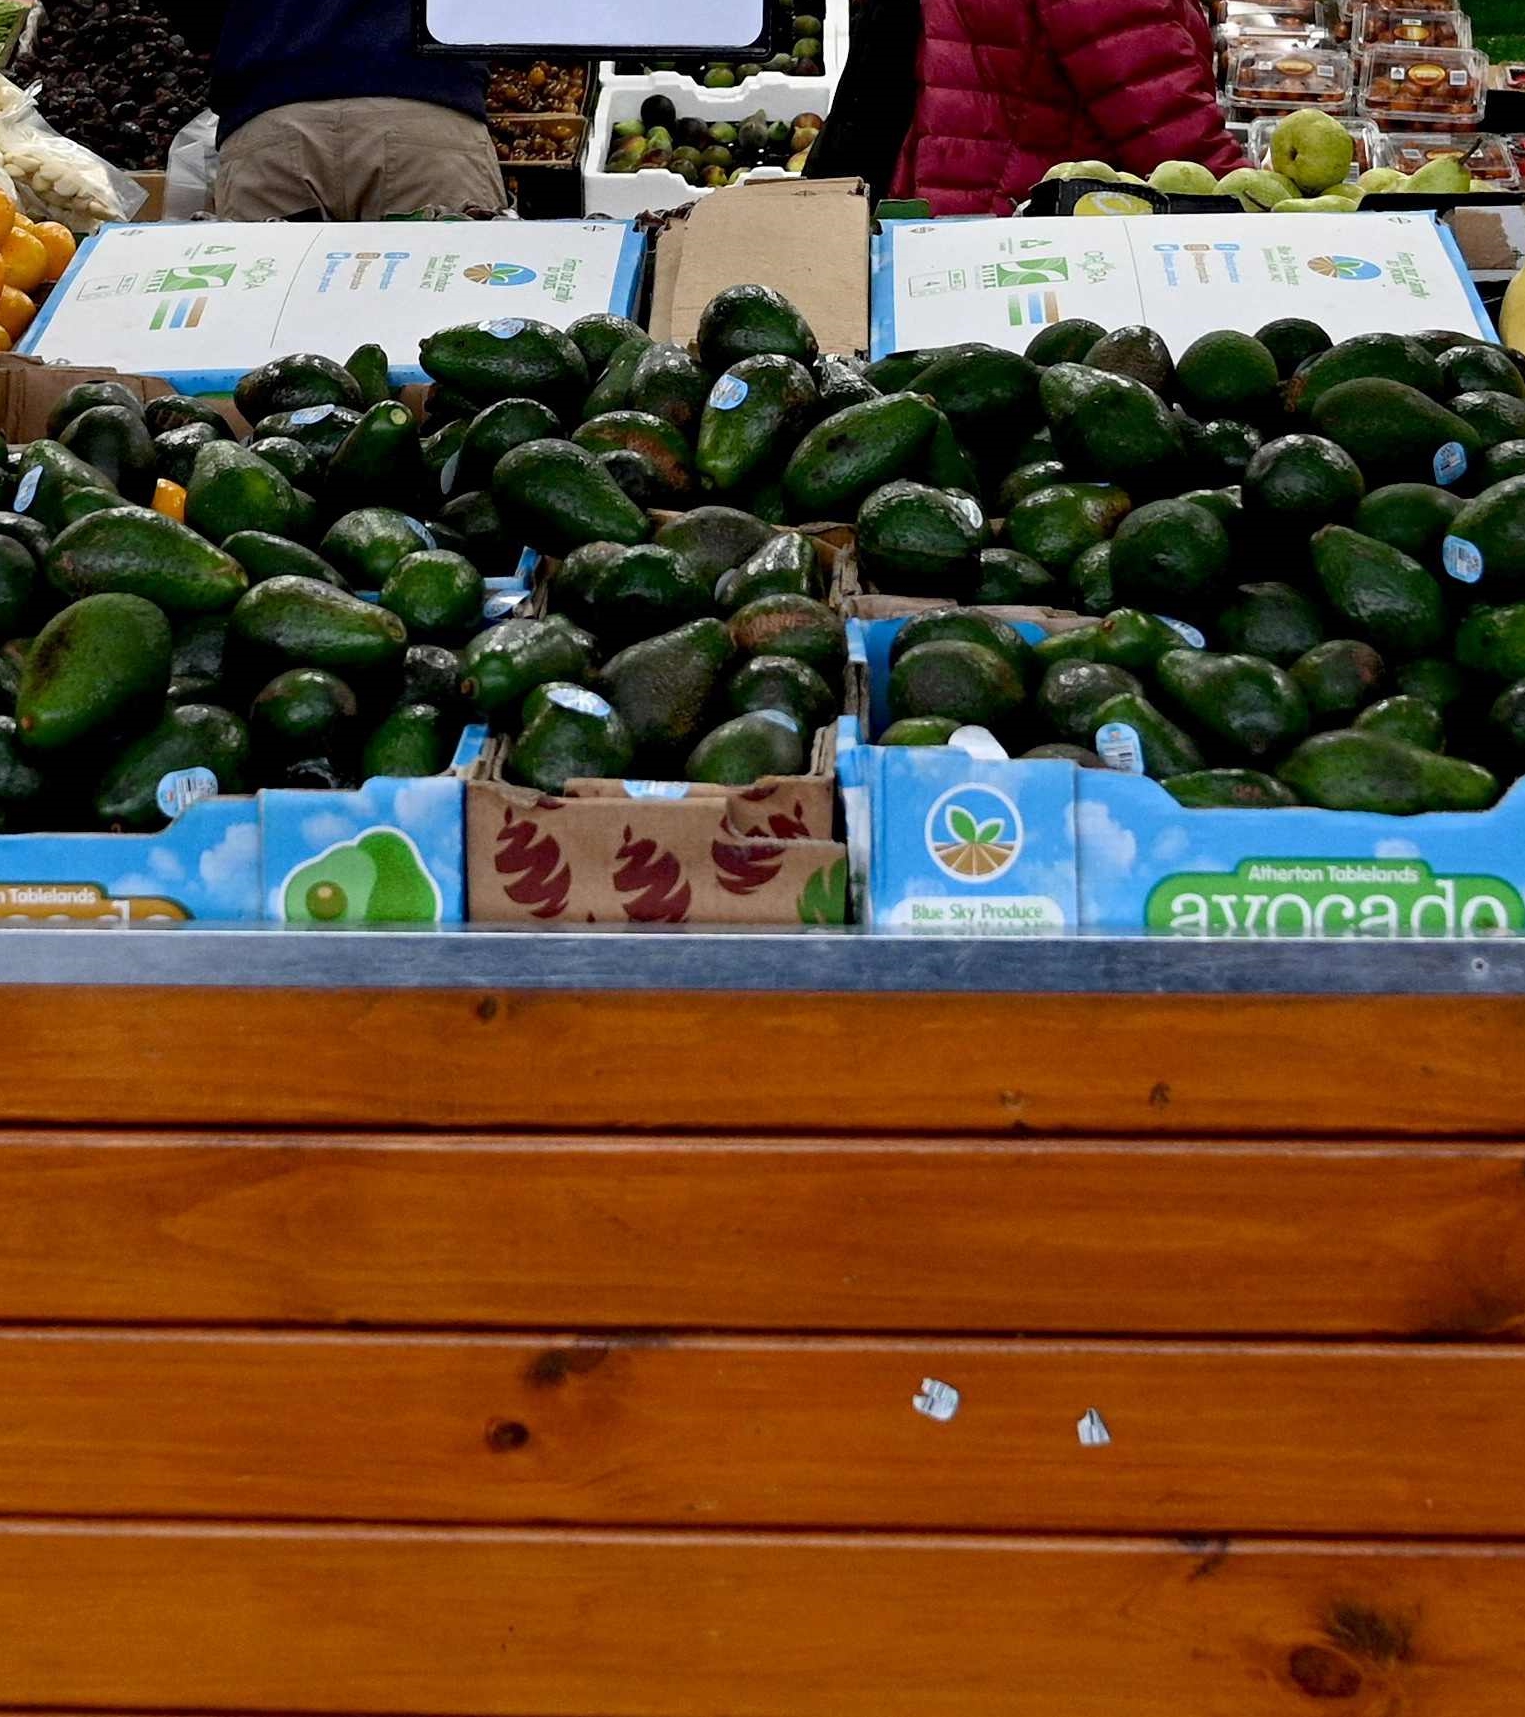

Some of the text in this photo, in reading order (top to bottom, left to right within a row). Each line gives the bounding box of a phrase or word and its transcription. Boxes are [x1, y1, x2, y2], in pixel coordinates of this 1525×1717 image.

[1248, 865, 1419, 883] Atherton Tablelands
[12, 888, 97, 905] Tablelands
[912, 902, 1043, 923] Blue Sky Produce
[1170, 878, 1509, 938] avocado
